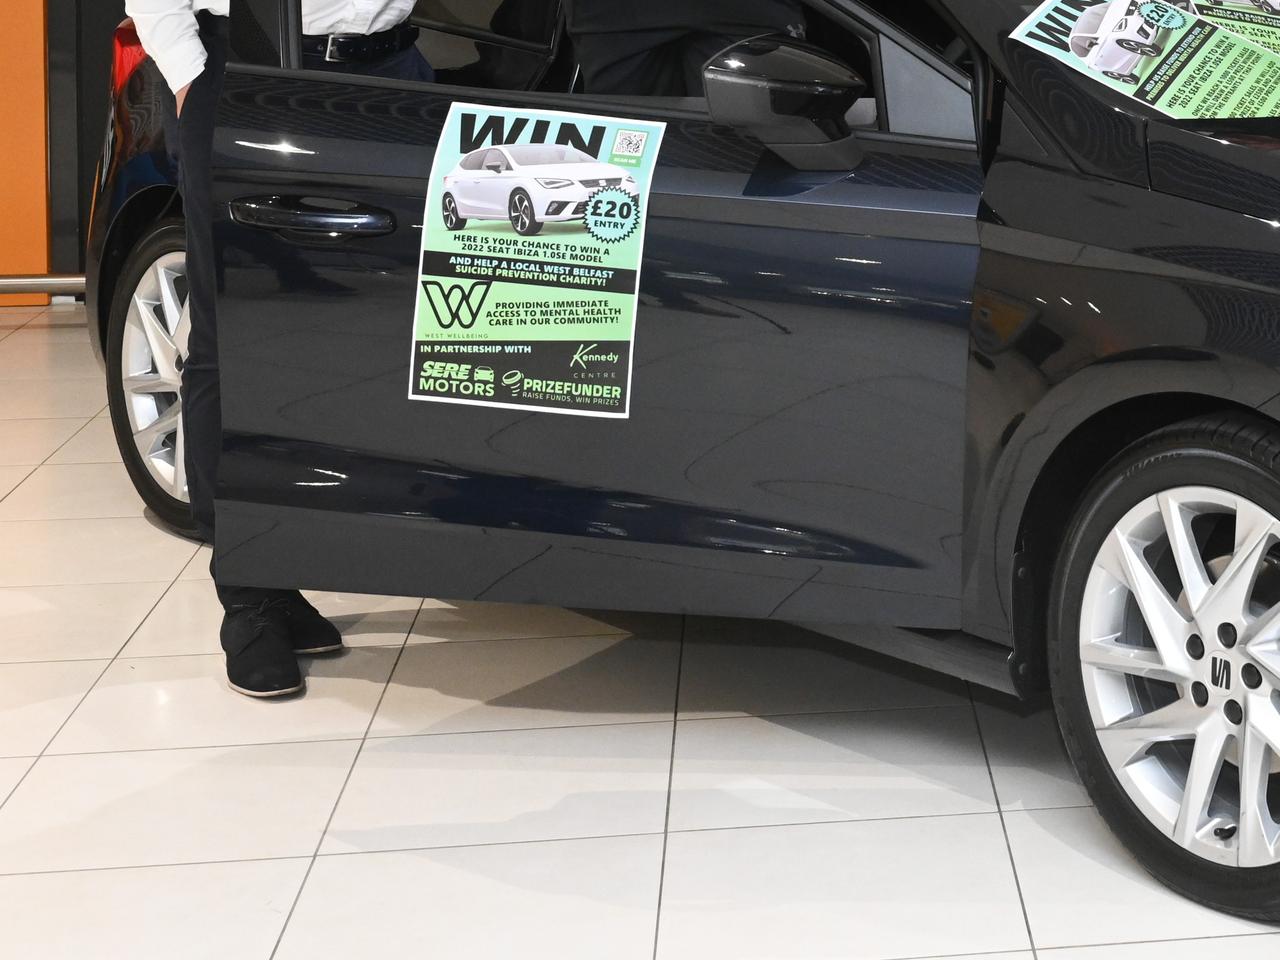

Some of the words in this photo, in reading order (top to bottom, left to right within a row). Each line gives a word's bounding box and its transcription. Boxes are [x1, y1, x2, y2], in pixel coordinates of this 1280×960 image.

[1145, 4, 1169, 22] £20
[1165, 94, 1182, 108] HERE
[1180, 74, 1197, 89] YOUR
[1191, 55, 1213, 75] CHANCE
[1208, 48, 1218, 56] TO
[1214, 39, 1226, 49] WIN
[460, 113, 606, 160] WIN
[591, 200, 632, 218] £20
[594, 220, 626, 230] ENTRY
[453, 234, 477, 242] HERE
[479, 236, 490, 244] IS
[492, 237, 518, 247] YOUR
[521, 240, 560, 251] CHANCE
[563, 244, 577, 253] TO
[580, 246, 600, 254] WIN
[461, 243, 484, 252] 2022
[487, 245, 510, 255] SEAT
[513, 247, 539, 257] IBIZA
[542, 250, 566, 260] 1.0SE
[569, 253, 603, 263] MODEL
[450, 256, 471, 265] AND
[474, 258, 498, 268] HELP
[501, 261, 508, 269] A
[511, 262, 541, 273] LOCAL
[543, 265, 571, 275] WEST
[573, 267, 614, 279] BELFAST
[455, 266, 493, 275] SUICIDE
[495, 268, 558, 281] PREVENTION
[560, 274, 606, 286] CHARITY!
[486, 309, 521, 317] ACCESS
[524, 309, 537, 317] TO
[539, 308, 580, 317] MENTAL
[582, 308, 622, 316] HEALTH
[496, 301, 550, 310] PROVIDING
[553, 300, 609, 308] IMMEDIATE
[488, 317, 513, 326] CARE
[516, 317, 527, 326] IN
[530, 317, 550, 325] OUR
[553, 316, 619, 325] COMMUNITY!
[420, 345, 432, 353] IN
[435, 345, 502, 353] PARTNERSHIP
[504, 345, 531, 353] WITH
[569, 343, 619, 369] Kennedy
[420, 360, 471, 379] SERE
[419, 378, 495, 397] MOTORS
[523, 378, 622, 399] PRIZEFUNDER
[522, 392, 543, 400] RAISE
[545, 394, 573, 403] FUNDS,
[575, 396, 590, 404] WIN
[593, 397, 619, 406] PRIZES
